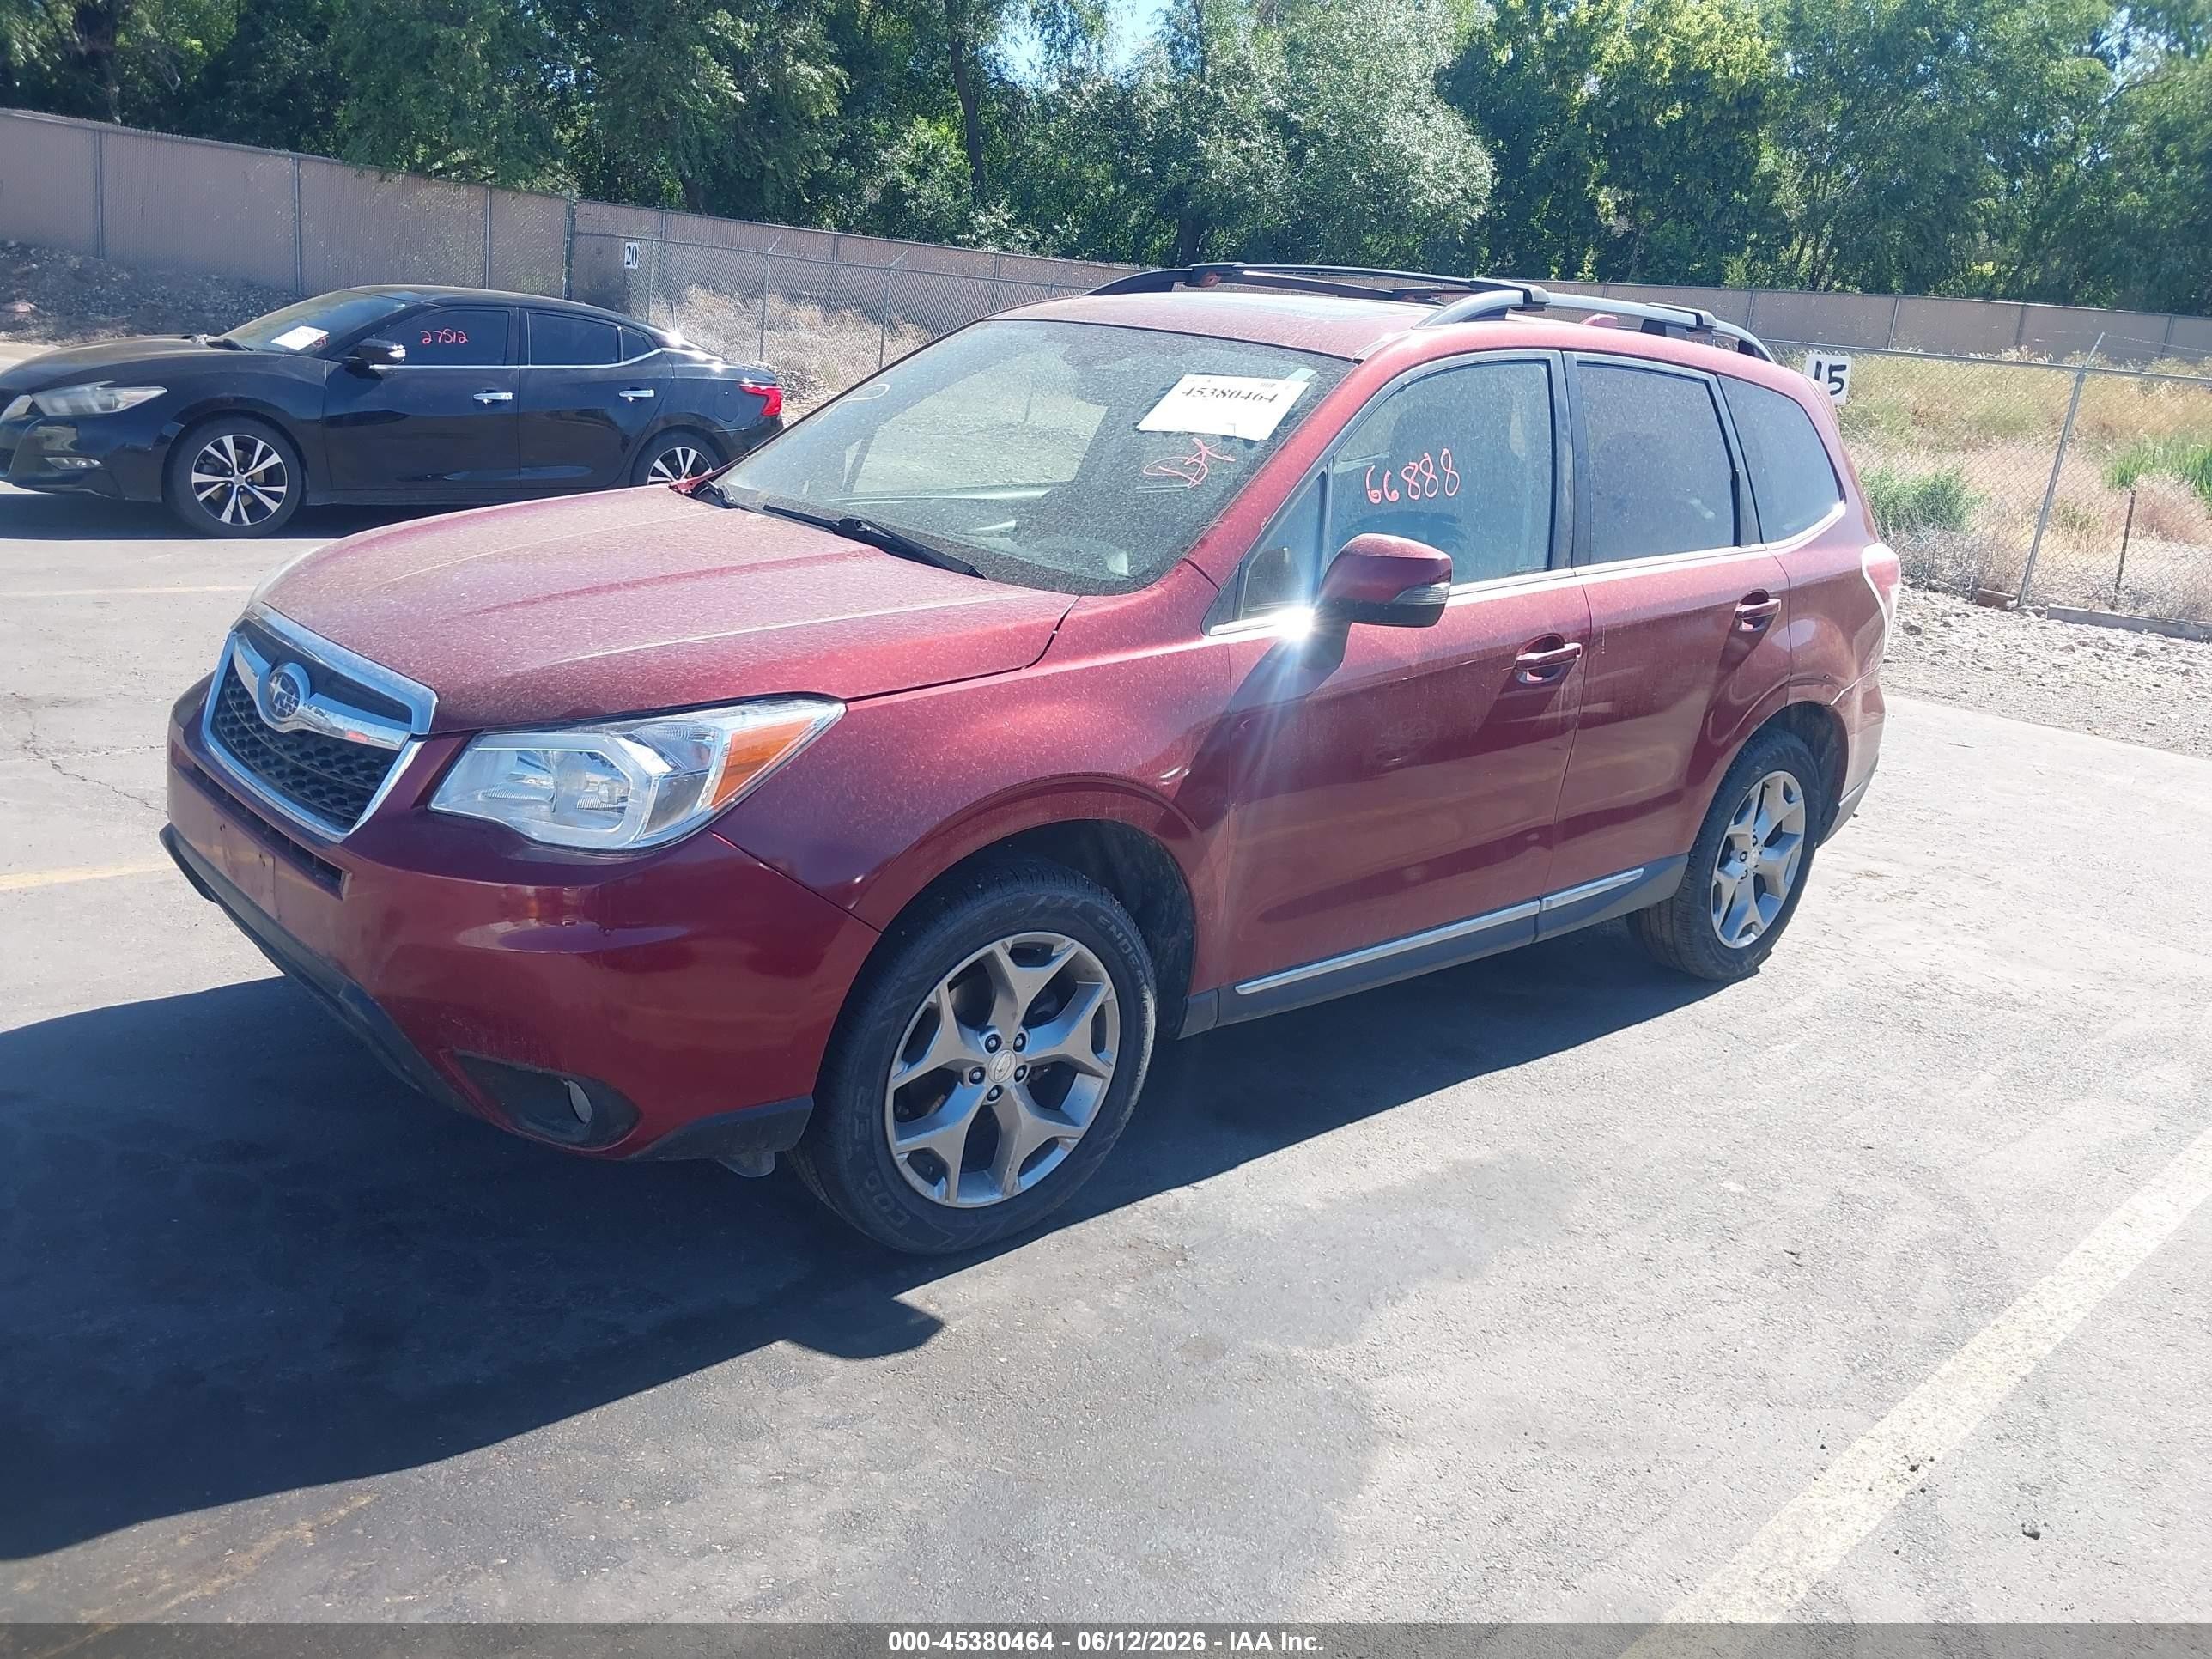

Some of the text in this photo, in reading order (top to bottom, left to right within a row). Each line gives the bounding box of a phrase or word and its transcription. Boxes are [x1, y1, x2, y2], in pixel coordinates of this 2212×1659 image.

[625, 245, 637, 266] 20
[420, 328, 468, 344] 27512
[1814, 361, 1847, 396] 15
[1182, 386, 1279, 403] 45380464
[1365, 448, 1460, 504] 66888
